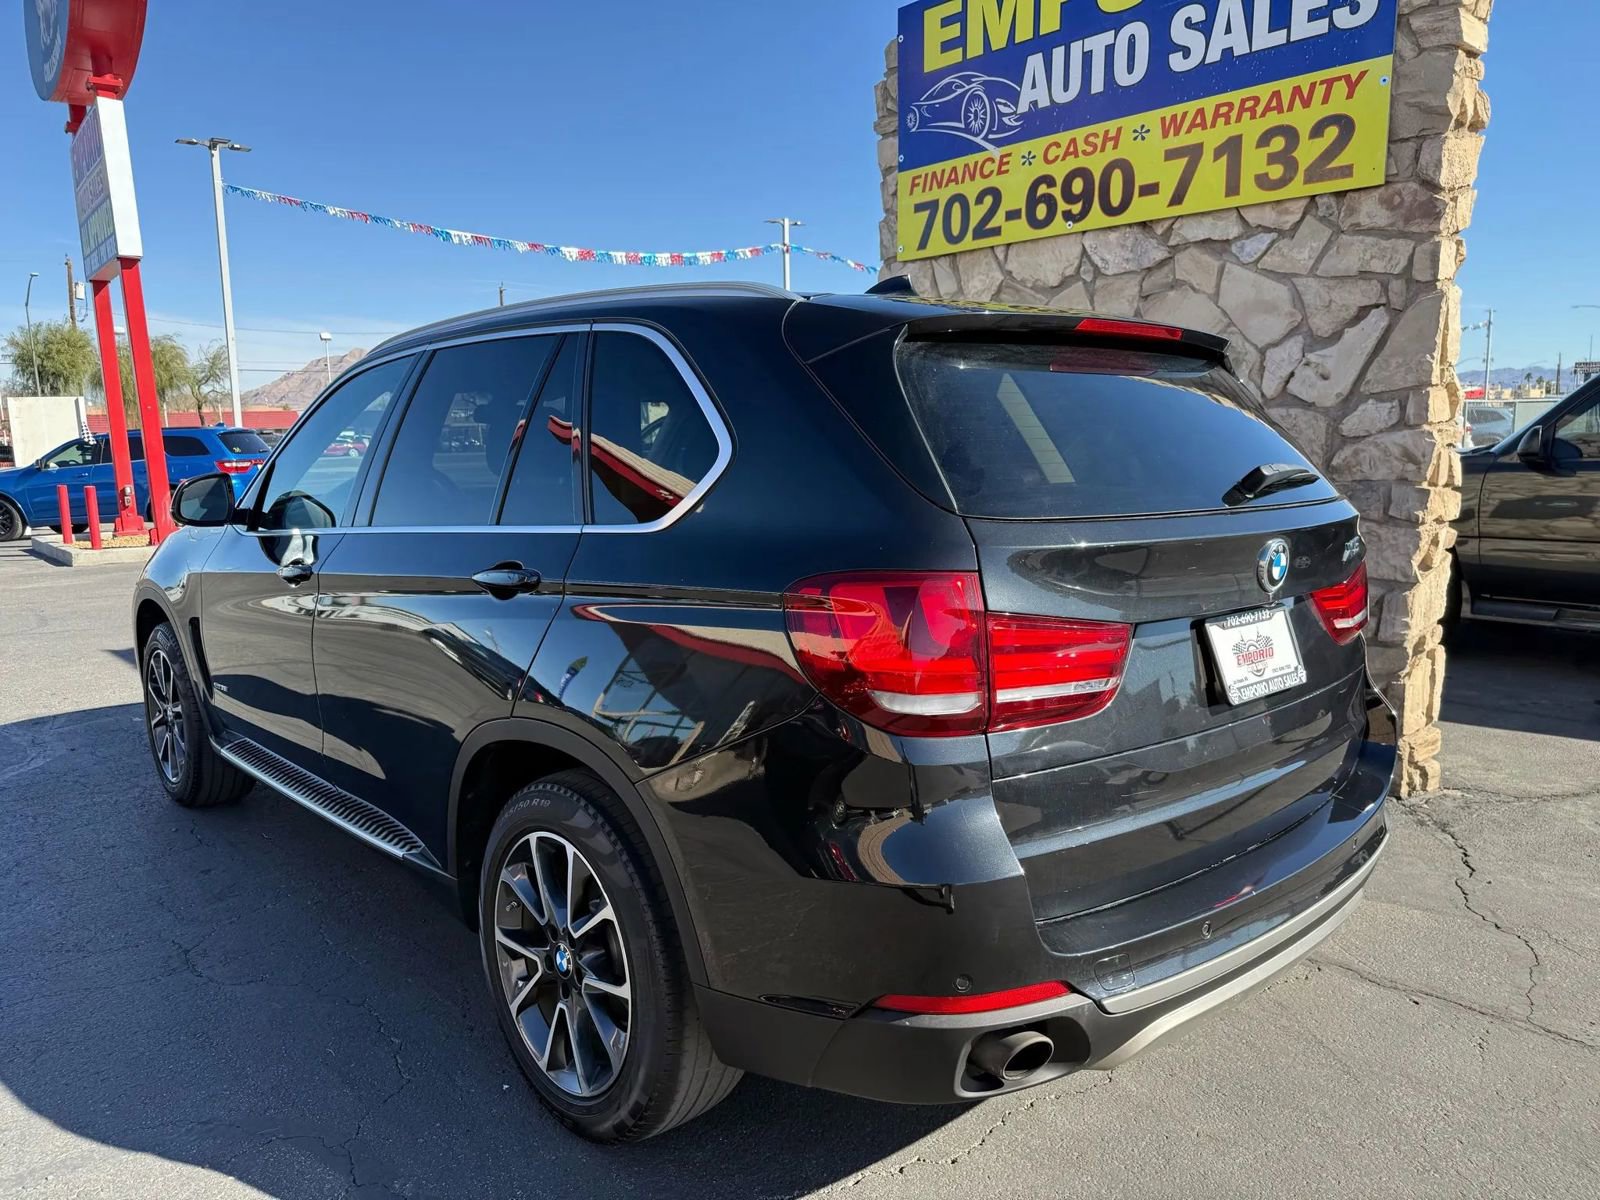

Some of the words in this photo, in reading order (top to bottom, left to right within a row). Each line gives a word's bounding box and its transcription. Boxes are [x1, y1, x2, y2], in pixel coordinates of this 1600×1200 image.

[924, 0, 1142, 73] EM
[1017, 21, 1150, 114] AUTO
[909, 152, 1013, 195] FINANCE
[1042, 127, 1123, 165] CASH
[1160, 69, 1370, 139] WARRANTY
[913, 113, 1356, 251] 702-690-7132
[1236, 646, 1274, 666] EMPORIO
[1241, 681, 1269, 700] EMPORIO
[1269, 677, 1285, 692] AUTO
